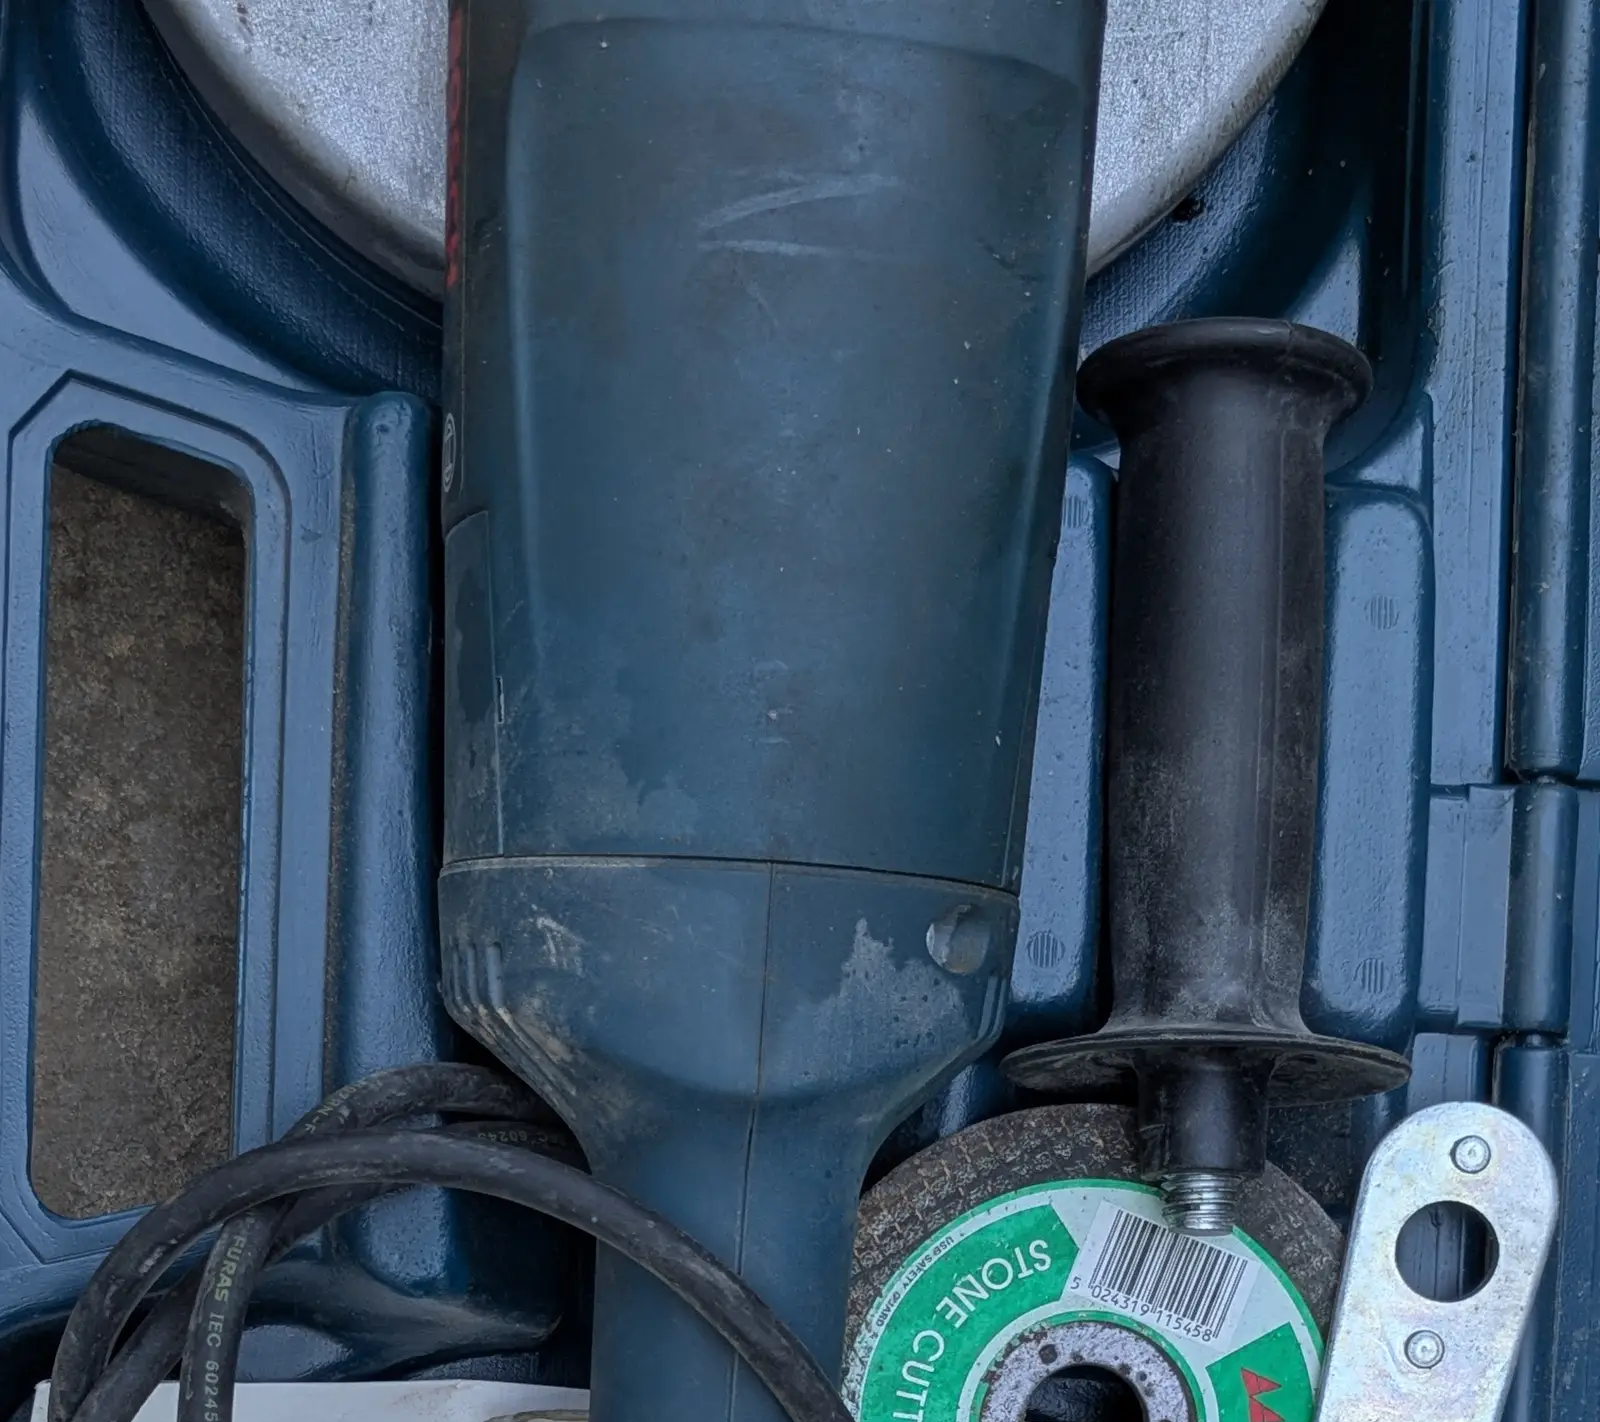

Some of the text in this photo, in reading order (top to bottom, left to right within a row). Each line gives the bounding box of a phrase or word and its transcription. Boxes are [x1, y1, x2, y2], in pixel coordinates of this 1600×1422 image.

[936, 1239, 1051, 1328] STONE
[1070, 1276, 1213, 1343] 5 024319 115458
[206, 1312, 224, 1348] IEC
[204, 1361, 219, 1422] 60245
